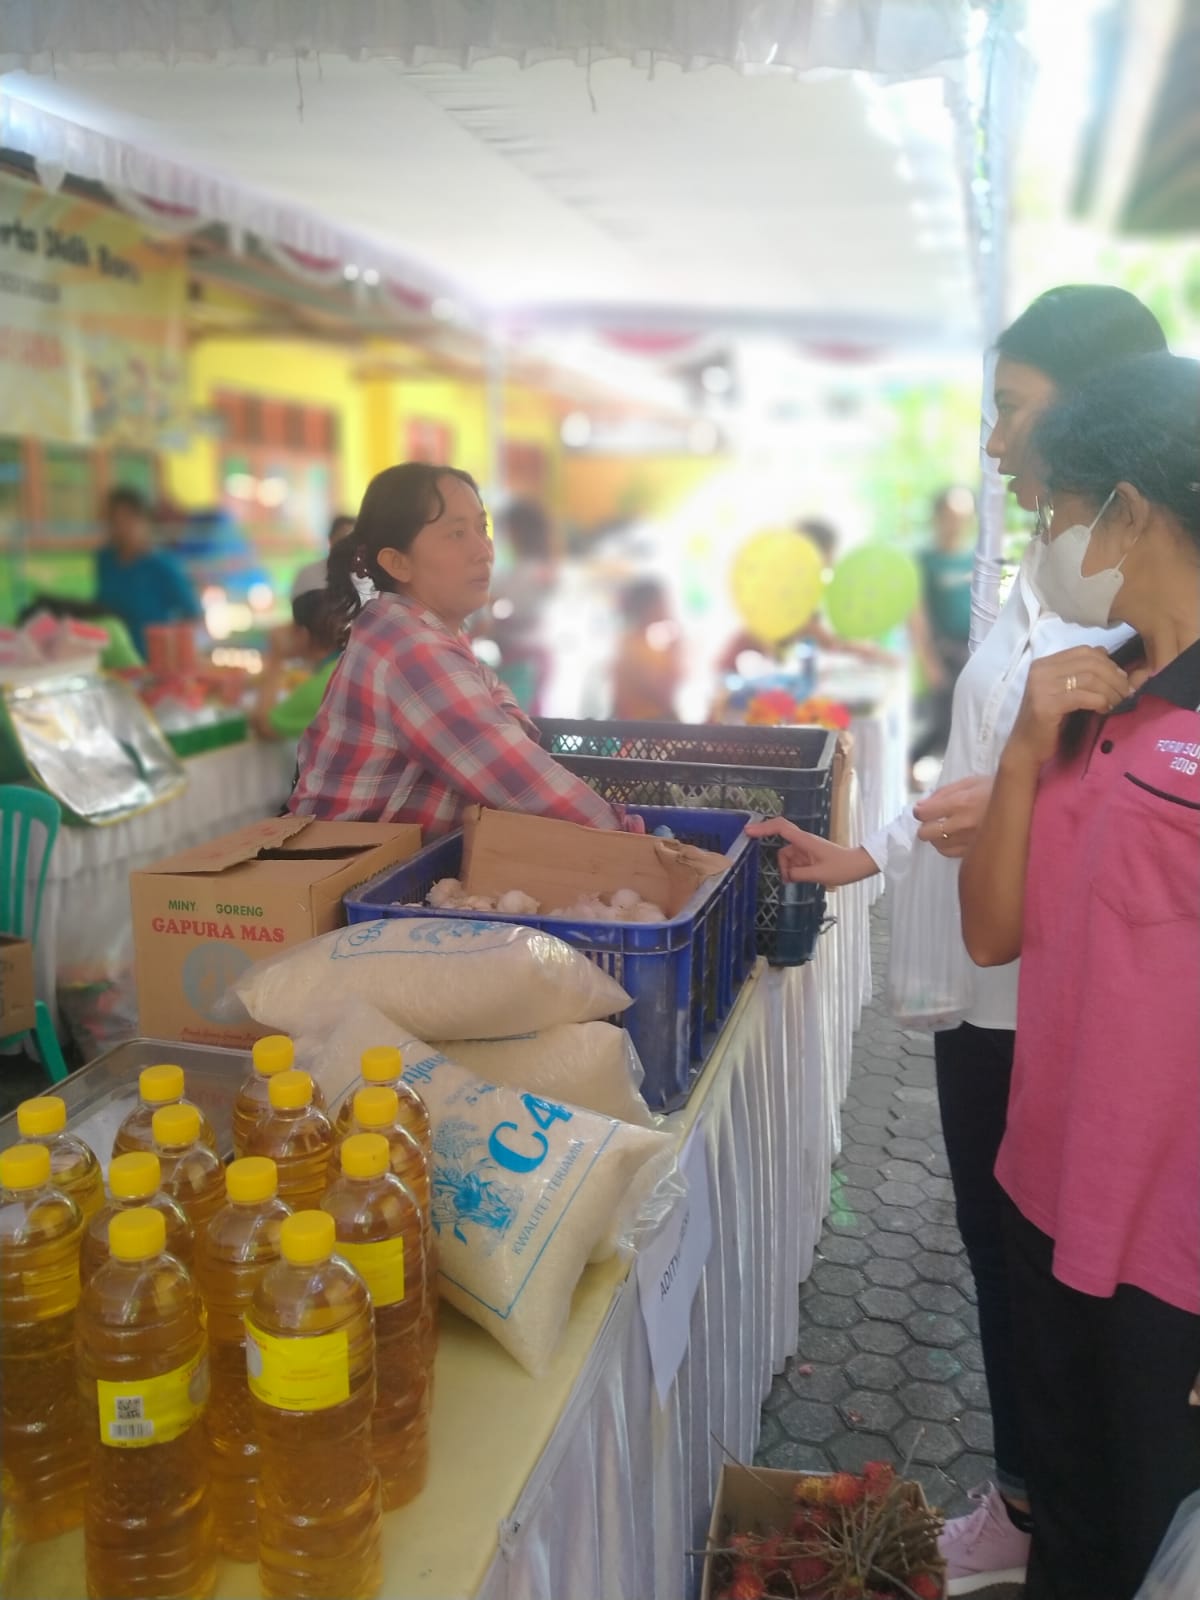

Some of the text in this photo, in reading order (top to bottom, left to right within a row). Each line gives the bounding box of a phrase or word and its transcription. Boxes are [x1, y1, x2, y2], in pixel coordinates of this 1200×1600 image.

[1170, 756, 1198, 775] 2018
[168, 899, 263, 917] MINY GORENG
[152, 917, 286, 943] GAPURA MAS
[488, 1093, 573, 1173] C4
[511, 1192, 553, 1255] KWALITET
